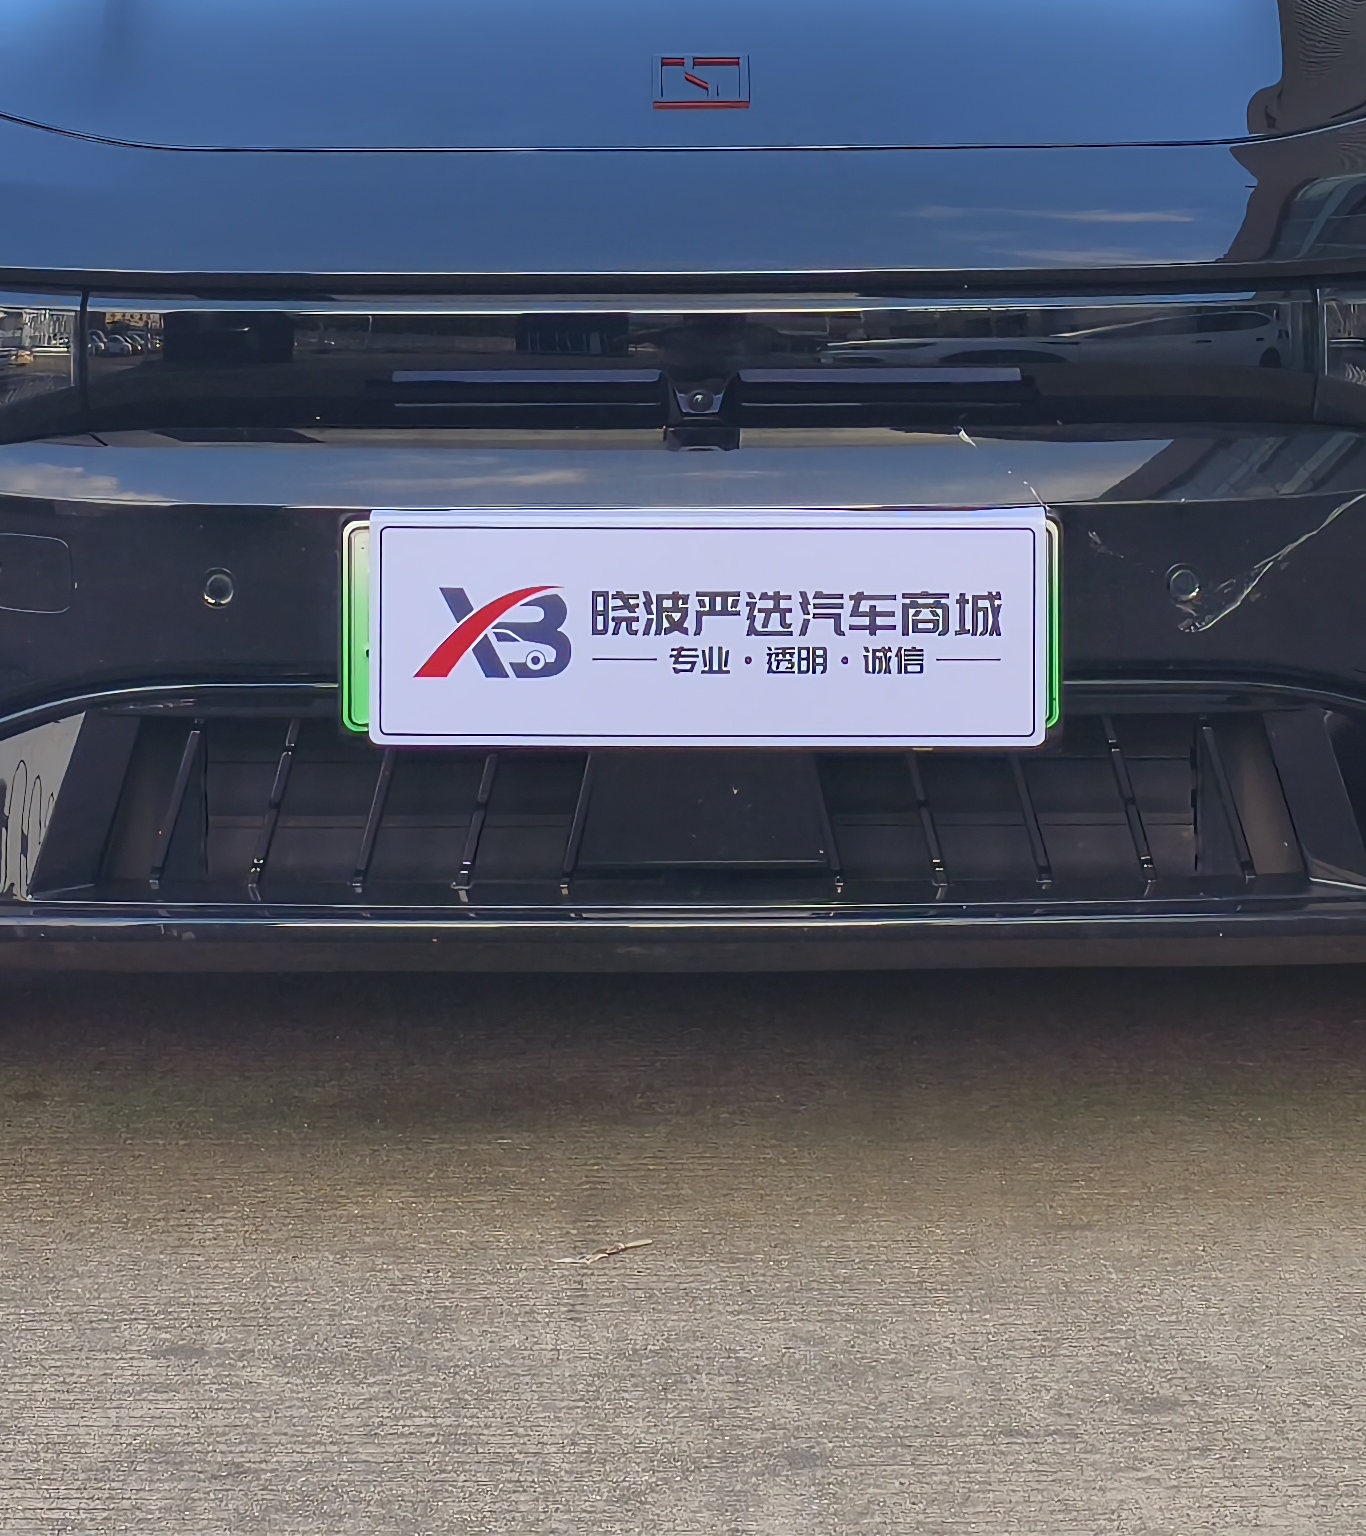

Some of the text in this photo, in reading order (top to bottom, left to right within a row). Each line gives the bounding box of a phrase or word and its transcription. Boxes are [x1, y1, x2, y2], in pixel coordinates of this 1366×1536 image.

[591, 590, 1002, 637] 晓波严选汽车商城
